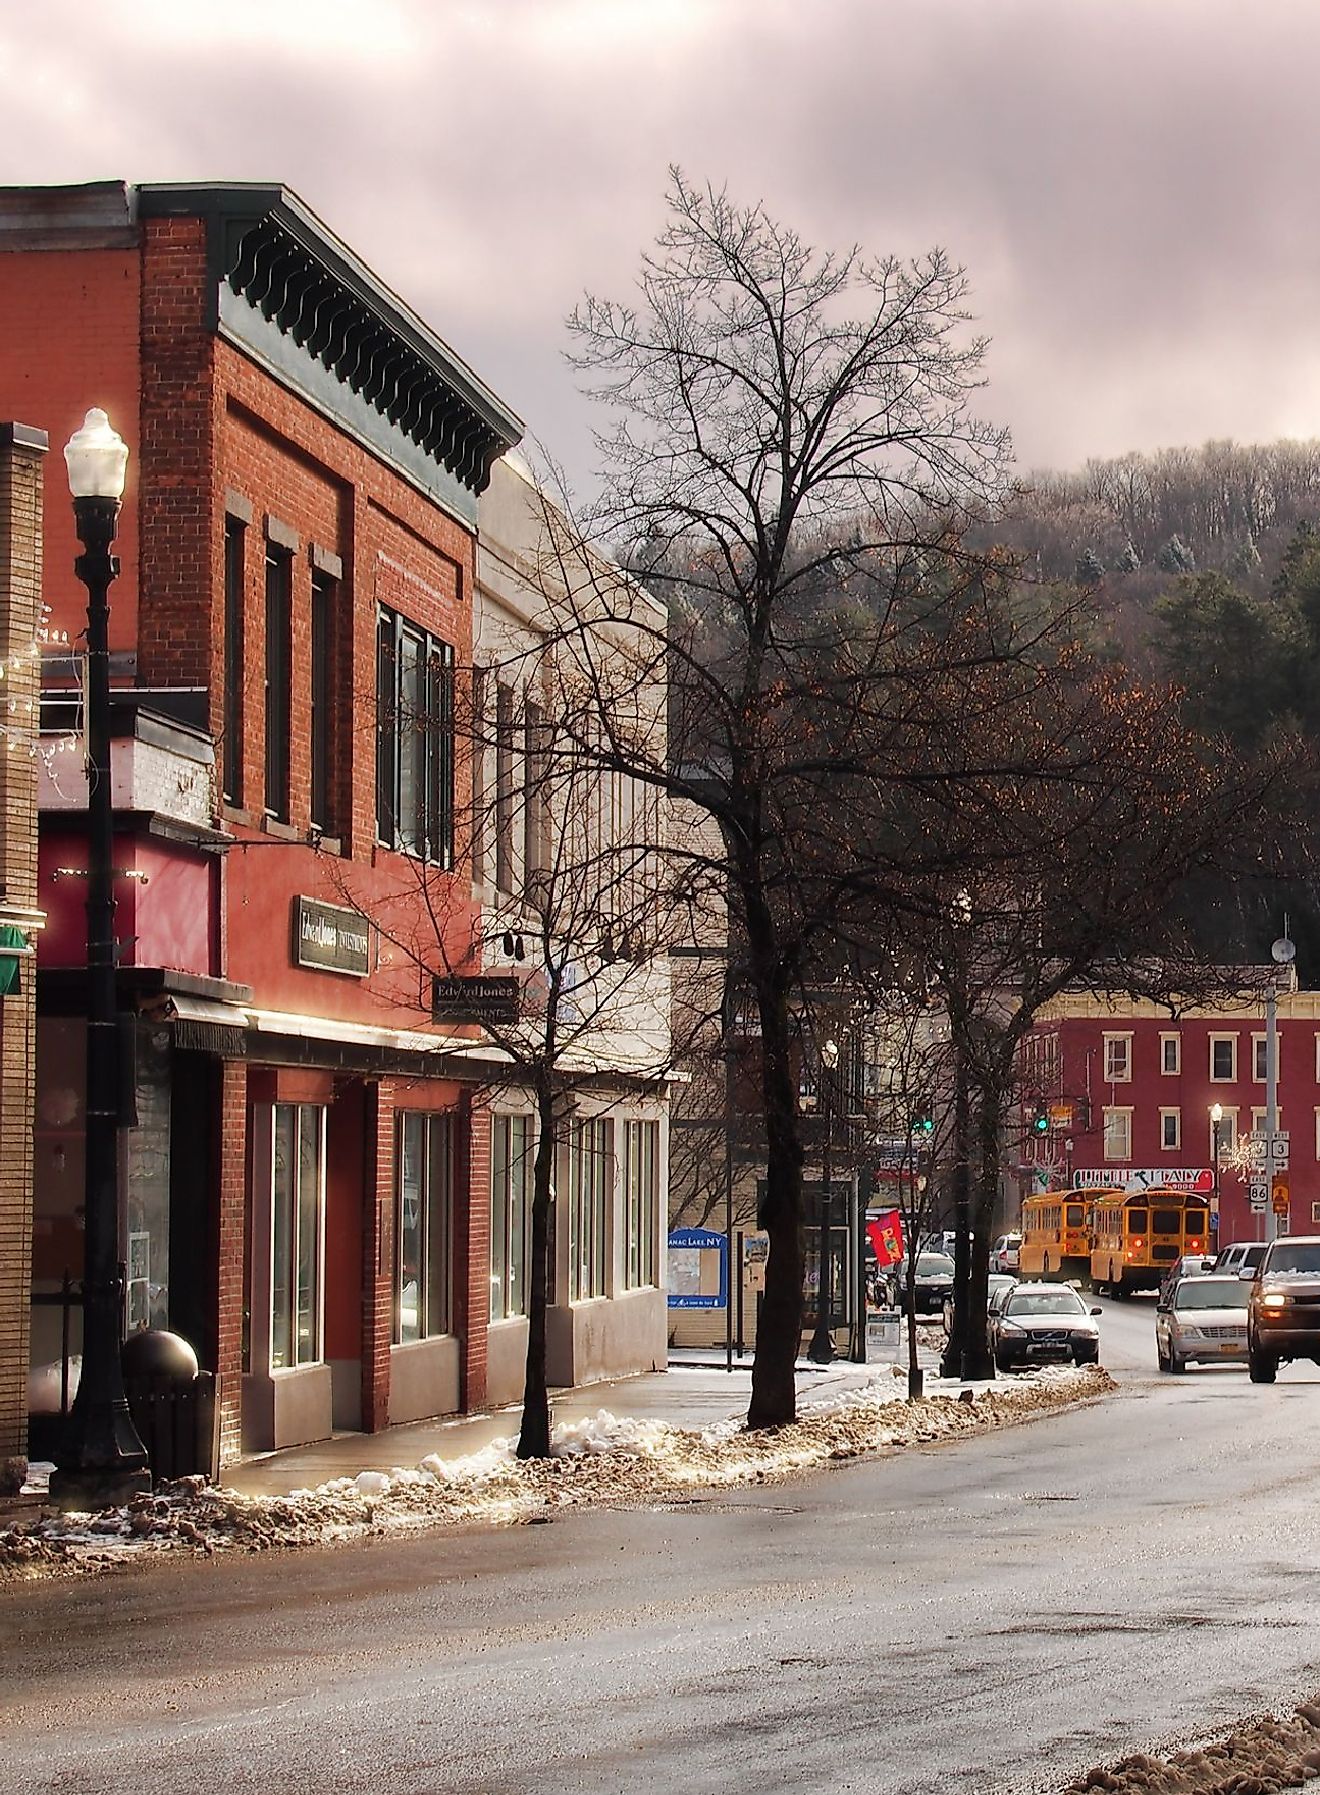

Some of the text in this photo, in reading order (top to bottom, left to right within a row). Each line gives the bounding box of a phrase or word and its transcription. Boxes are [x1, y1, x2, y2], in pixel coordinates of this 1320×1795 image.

[1277, 1144, 1284, 1154] 3
[1251, 1188, 1266, 1198] 86
[706, 1237, 722, 1246] NY
